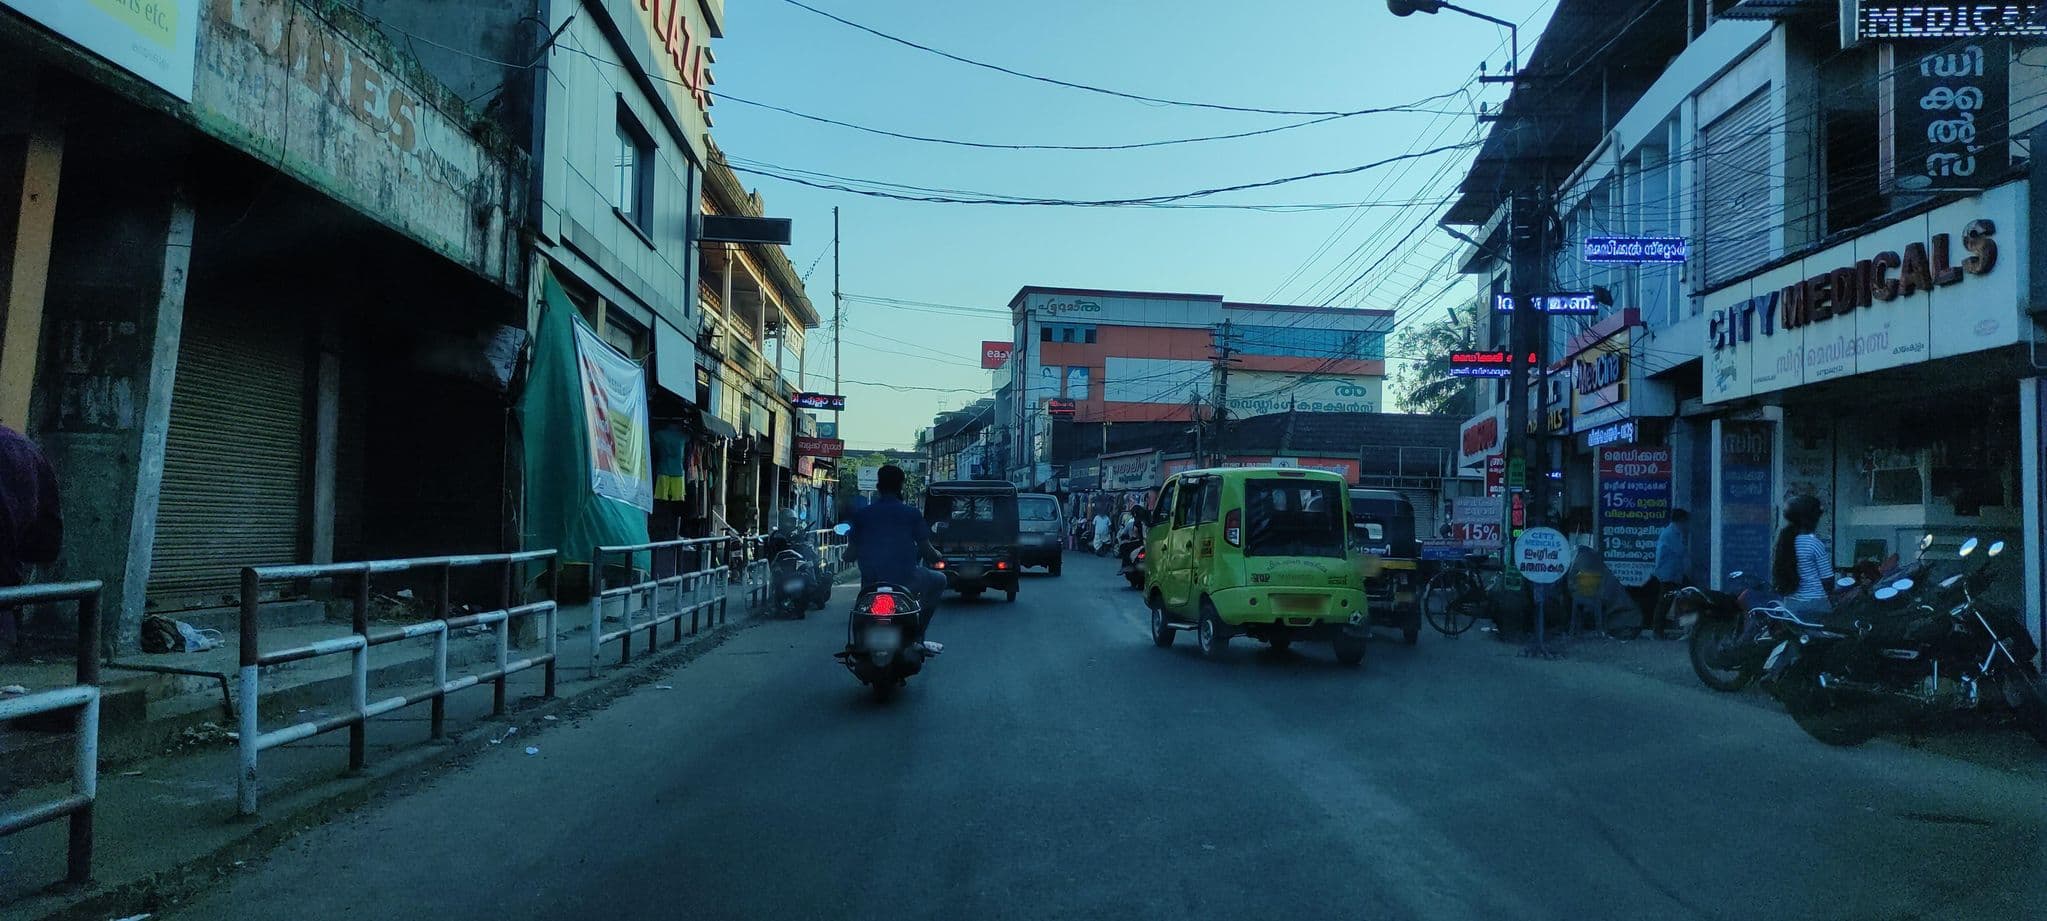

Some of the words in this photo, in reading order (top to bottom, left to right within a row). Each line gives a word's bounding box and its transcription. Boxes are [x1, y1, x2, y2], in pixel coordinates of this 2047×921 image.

[640, 0, 704, 111] LAZA
[1708, 291, 1780, 350] CITY
[1780, 219, 1998, 331] MEDICALS
[1603, 449, 1668, 461] മെഡിക്കൽ
[1462, 523, 1498, 540] 15%
